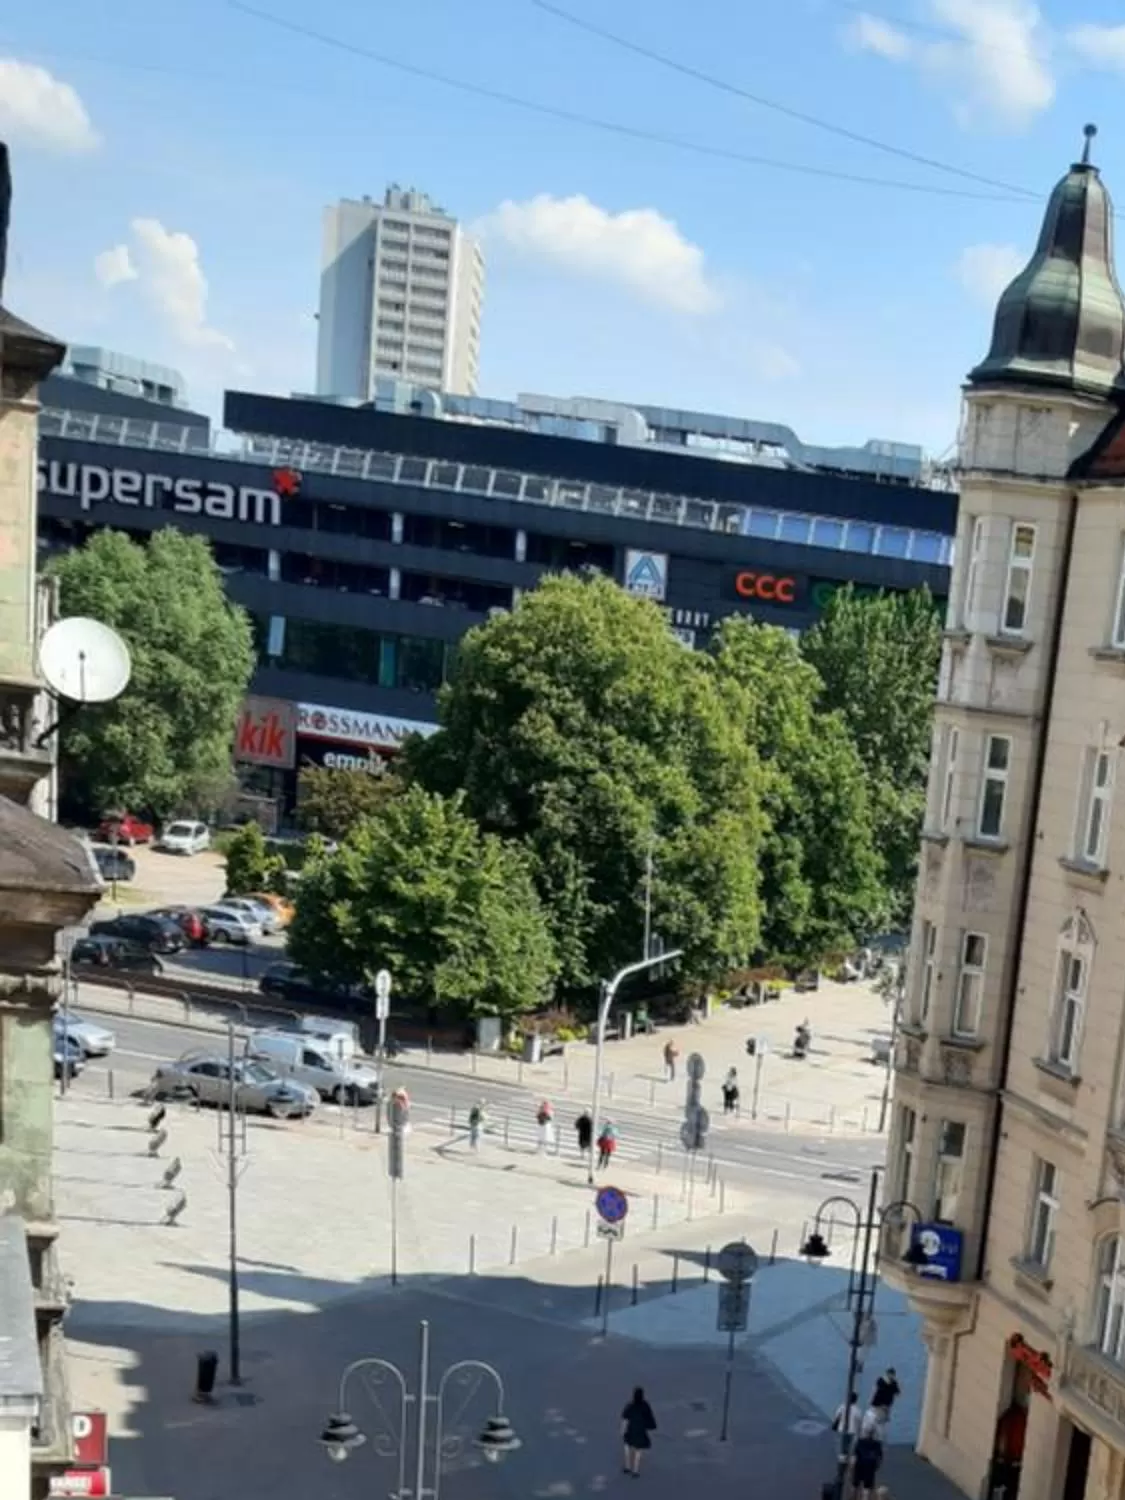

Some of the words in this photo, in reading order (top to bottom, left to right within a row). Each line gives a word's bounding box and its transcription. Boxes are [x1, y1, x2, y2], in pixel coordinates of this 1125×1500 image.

[36, 459, 281, 525] supersam
[735, 571, 796, 602] CCC
[239, 711, 286, 758] kik
